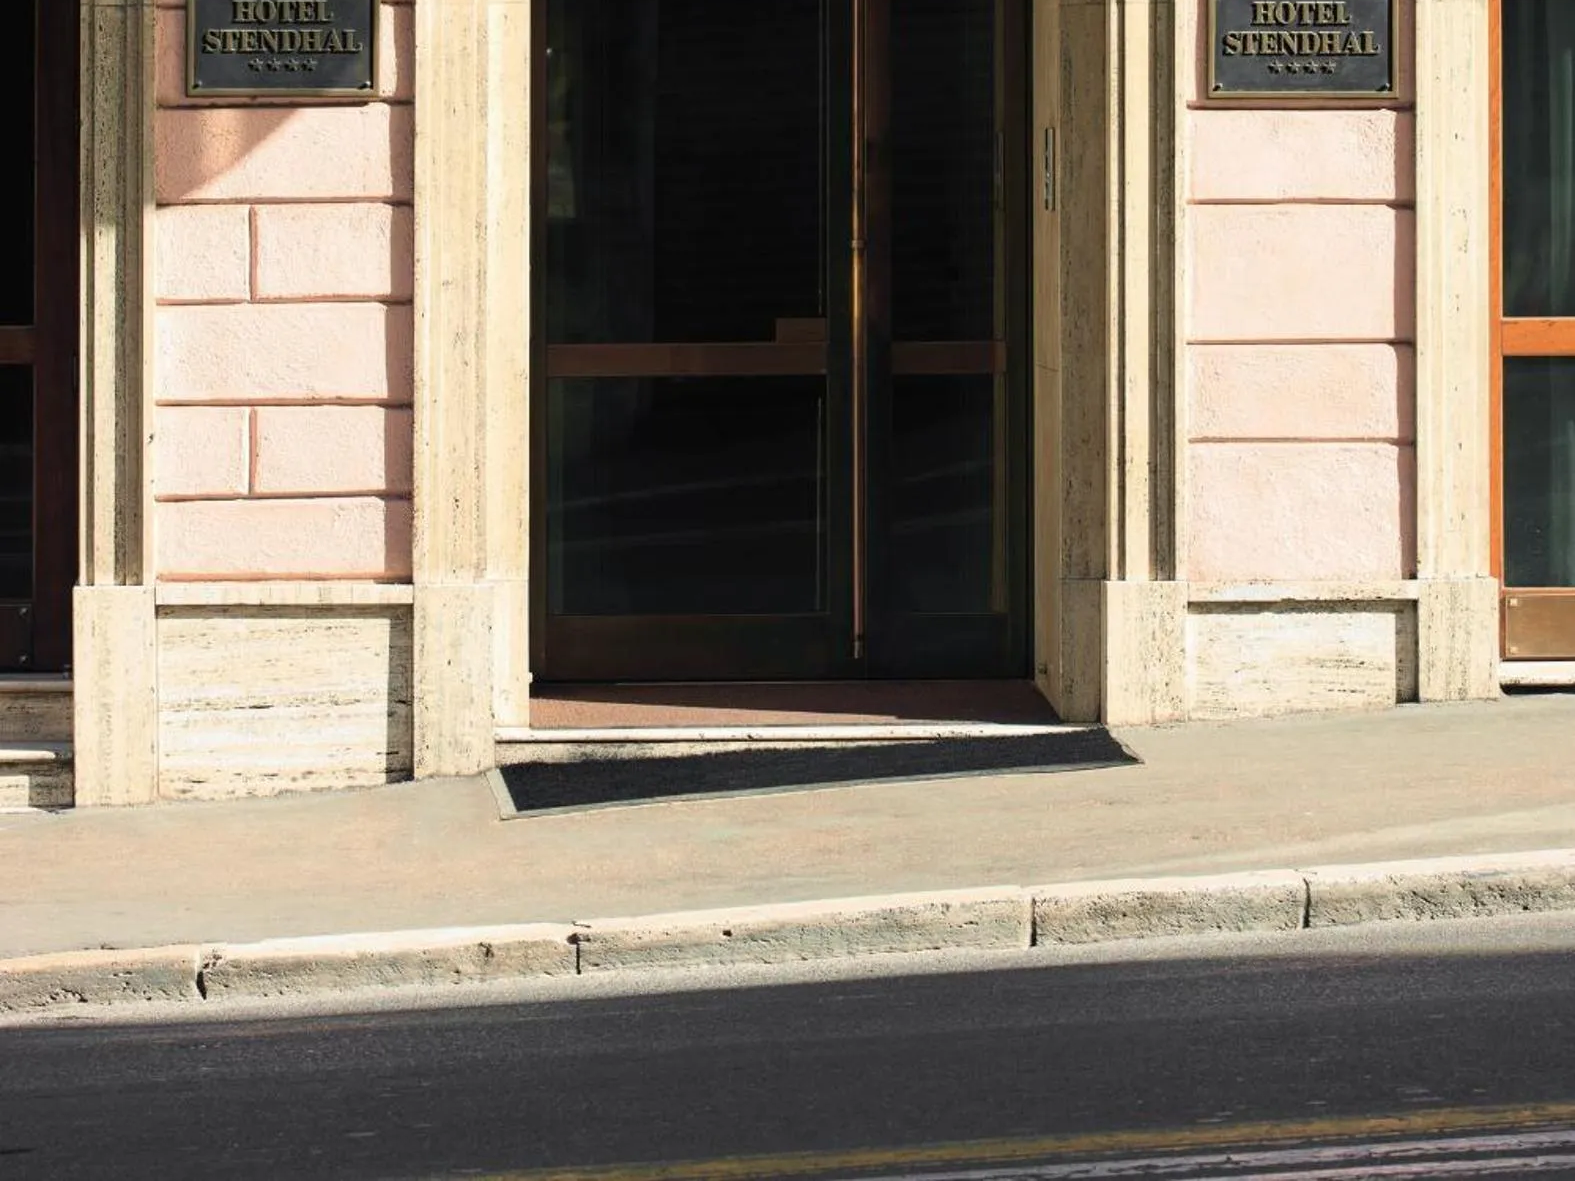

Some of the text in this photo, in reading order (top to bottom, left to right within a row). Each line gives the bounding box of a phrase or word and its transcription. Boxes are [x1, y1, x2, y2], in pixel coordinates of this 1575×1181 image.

[231, 0, 334, 24] HOTEL
[1251, 0, 1351, 26] HOTEL
[202, 28, 363, 55] STENDHAL
[1223, 30, 1382, 57] STENDHAL
